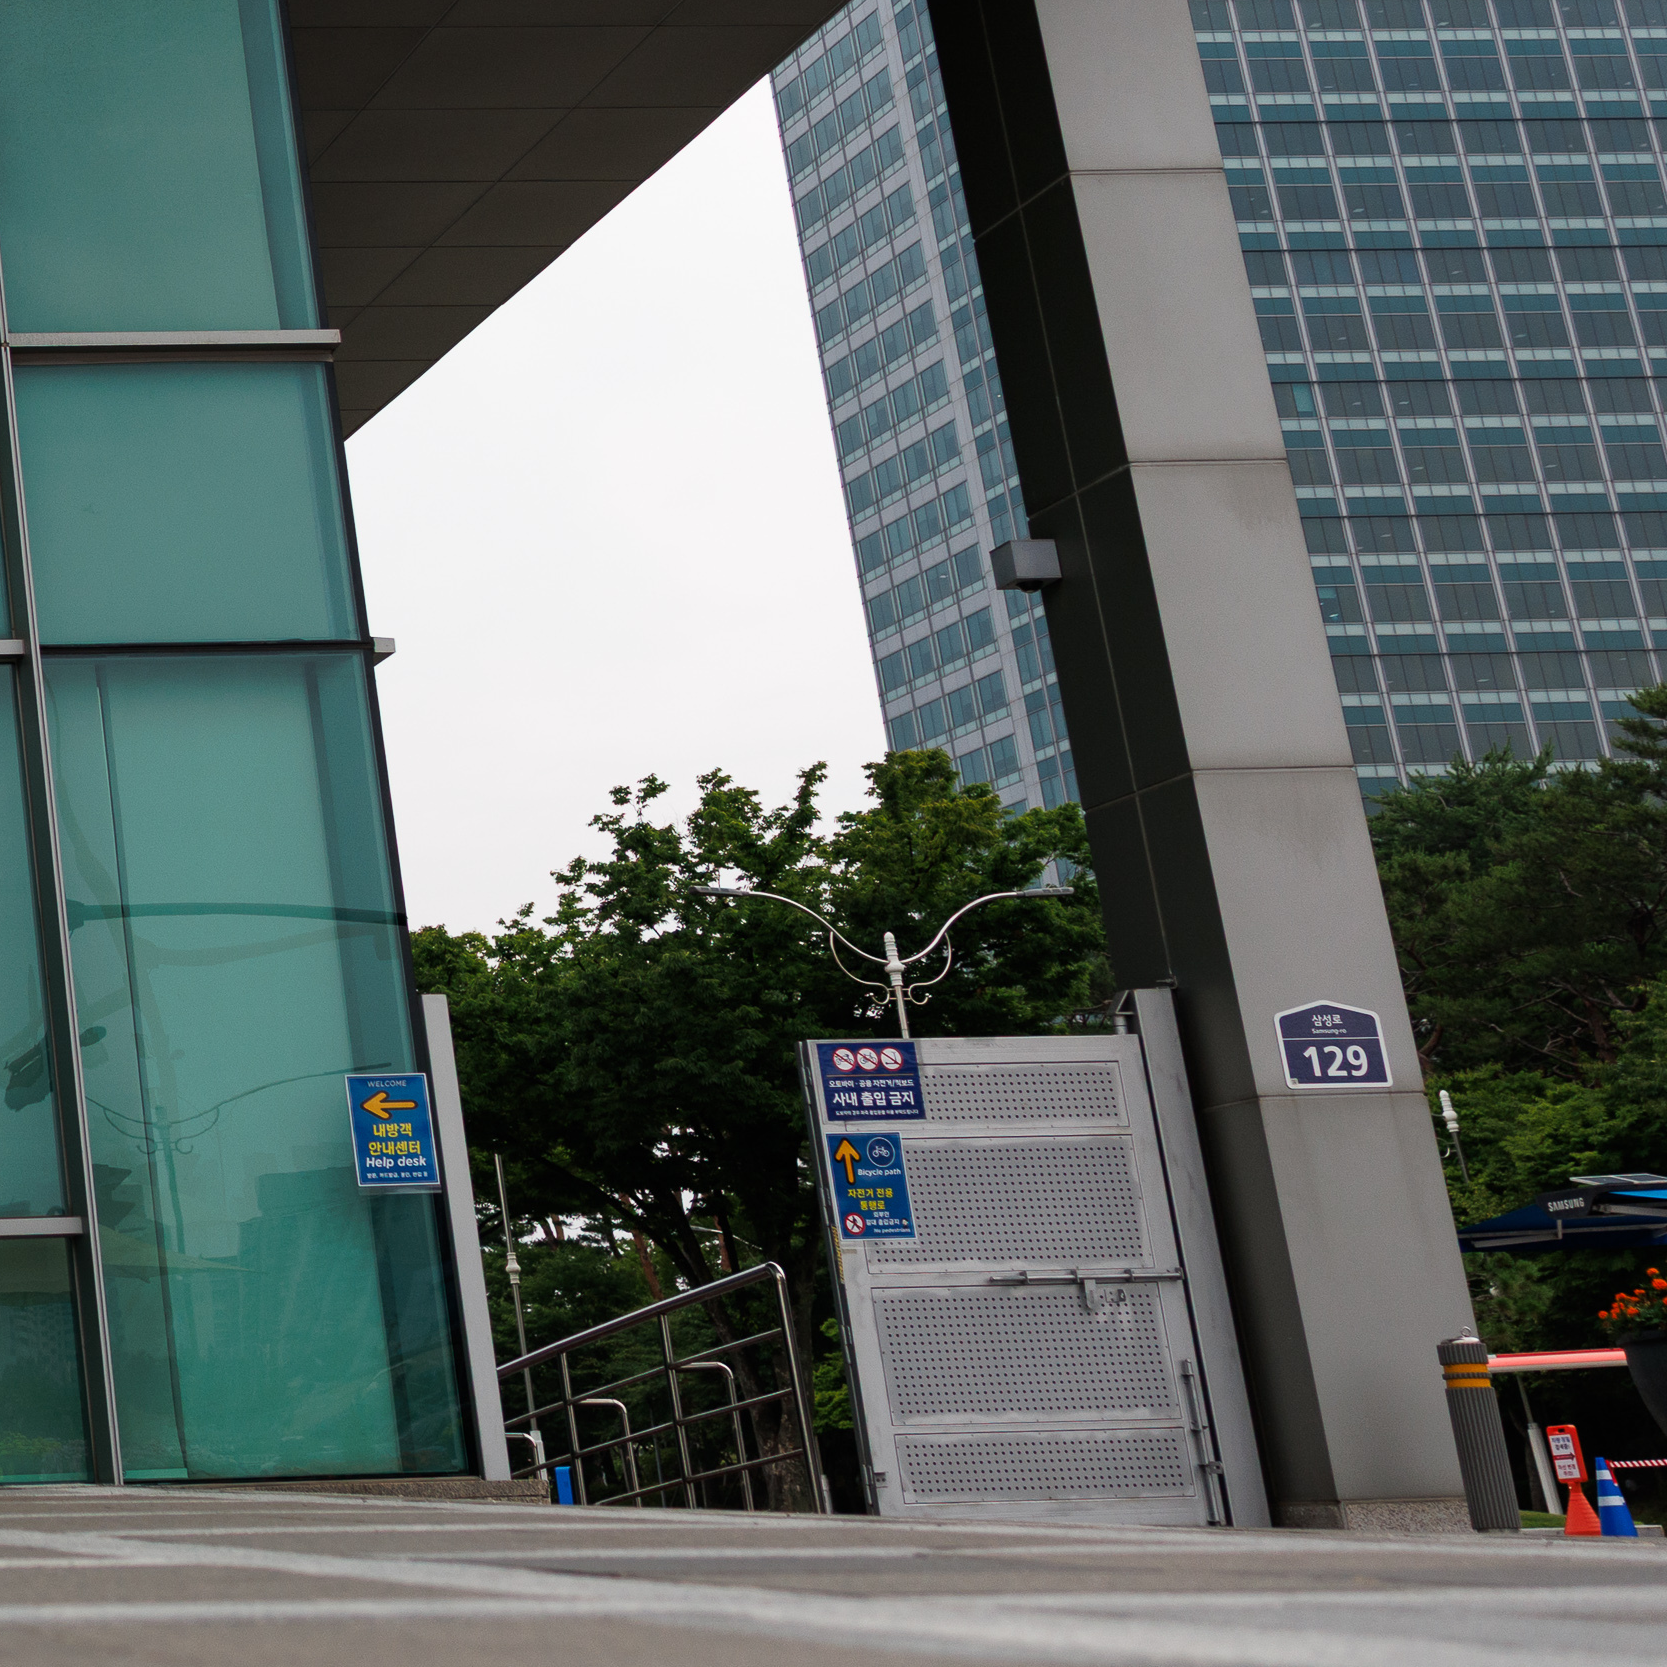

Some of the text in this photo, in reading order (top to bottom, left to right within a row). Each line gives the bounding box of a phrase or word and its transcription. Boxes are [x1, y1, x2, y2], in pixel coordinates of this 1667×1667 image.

[1312, 1014, 1344, 1027] 삼성로
[1303, 1044, 1369, 1078] 129
[829, 1079, 855, 1088] 오토바이
[832, 1090, 915, 1107] 사내 출입 금지
[373, 1122, 412, 1138] 내방객
[368, 1140, 421, 1156] 안내센터
[366, 1155, 427, 1169] Help desk
[857, 1168, 901, 1177] Bicycle path
[847, 1188, 893, 1198] 자전거 전용
[860, 1200, 885, 1211] 통행로
[1546, 1197, 1585, 1213] SAMSUNG
